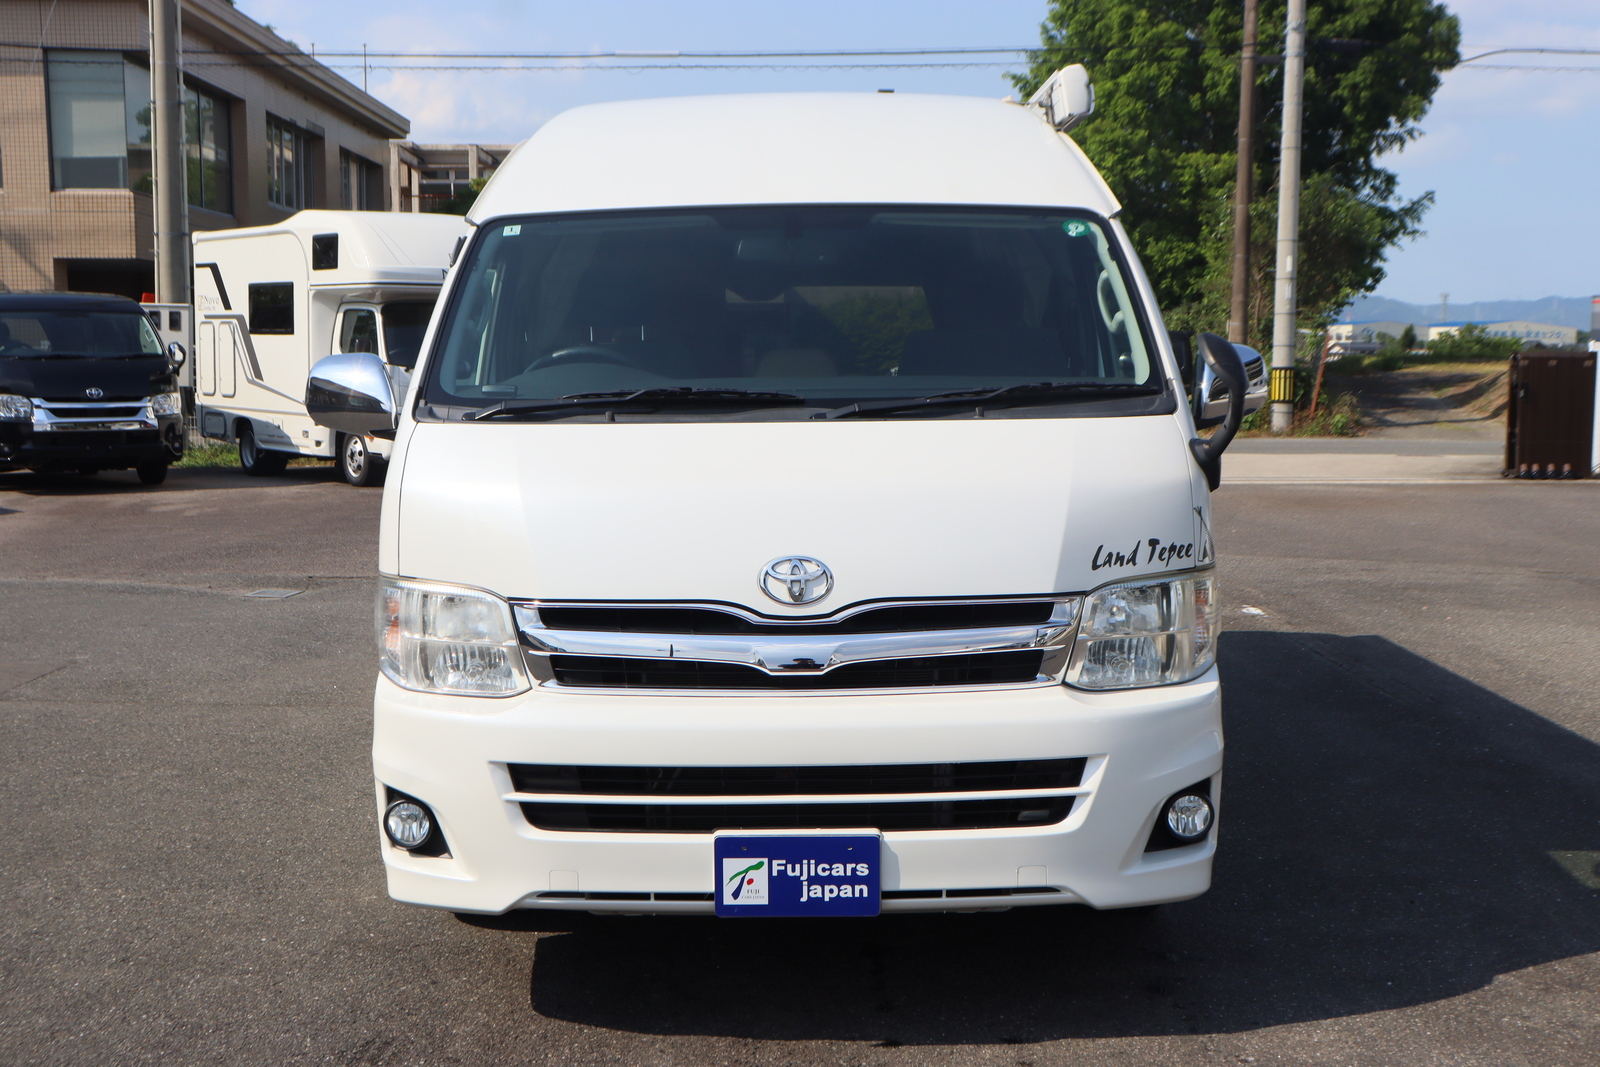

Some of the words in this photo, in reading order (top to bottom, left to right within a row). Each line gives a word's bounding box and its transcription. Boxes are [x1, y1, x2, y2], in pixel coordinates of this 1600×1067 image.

[1091, 539, 1141, 571] Land
[1147, 537, 1194, 568] Tepee
[771, 859, 870, 881] Fujicars
[799, 881, 868, 902] japan
